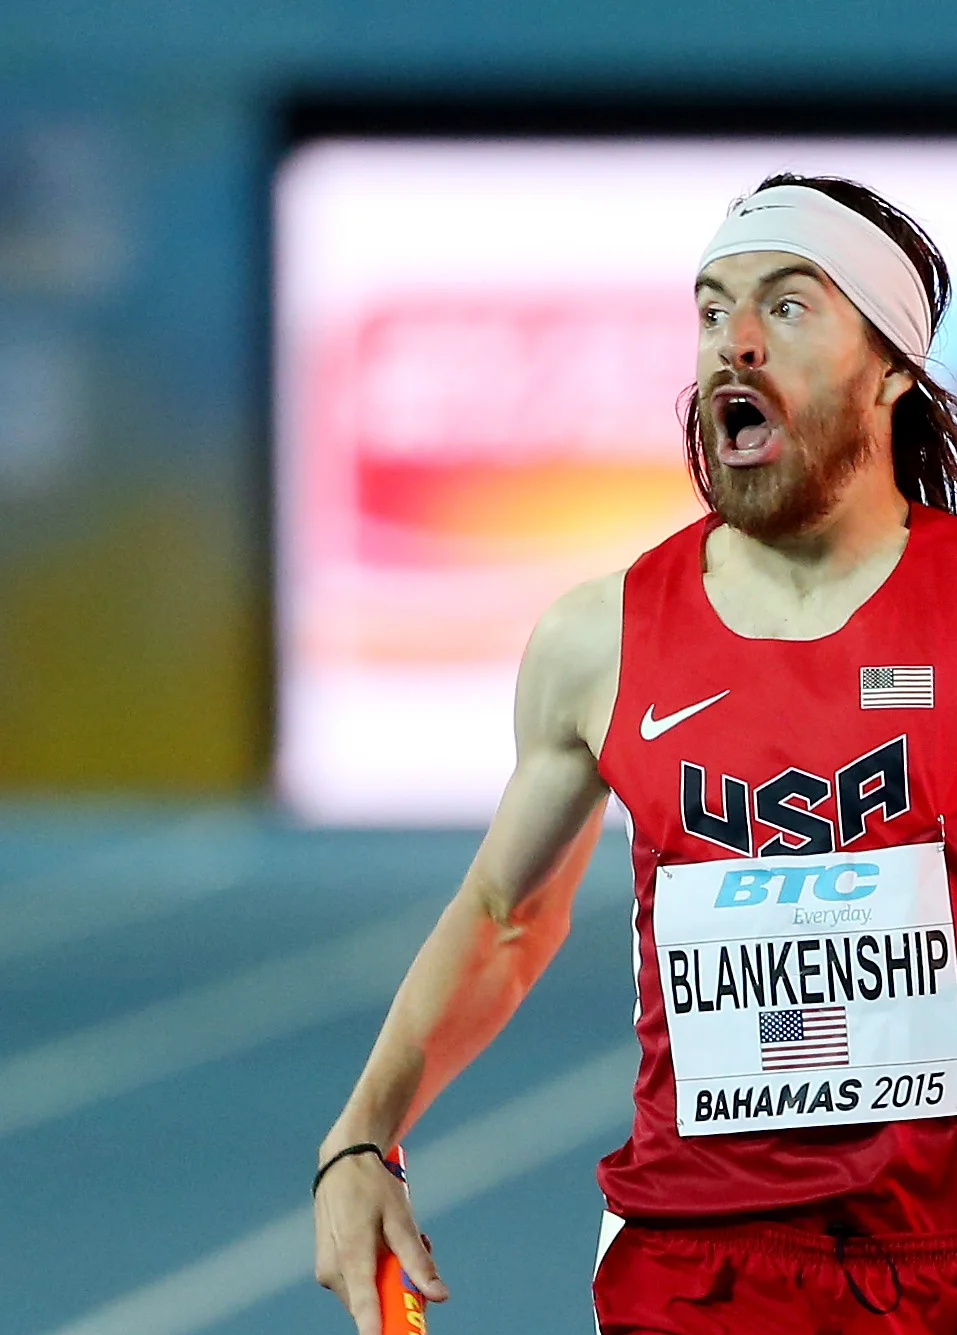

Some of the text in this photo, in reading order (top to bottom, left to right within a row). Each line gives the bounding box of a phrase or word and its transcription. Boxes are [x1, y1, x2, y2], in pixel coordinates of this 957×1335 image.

[680, 733, 910, 857] USA
[714, 862, 880, 909] BTC
[667, 929, 949, 1015] BLANKENSHIP
[694, 1072, 945, 1123] BAHAMAS 2015
